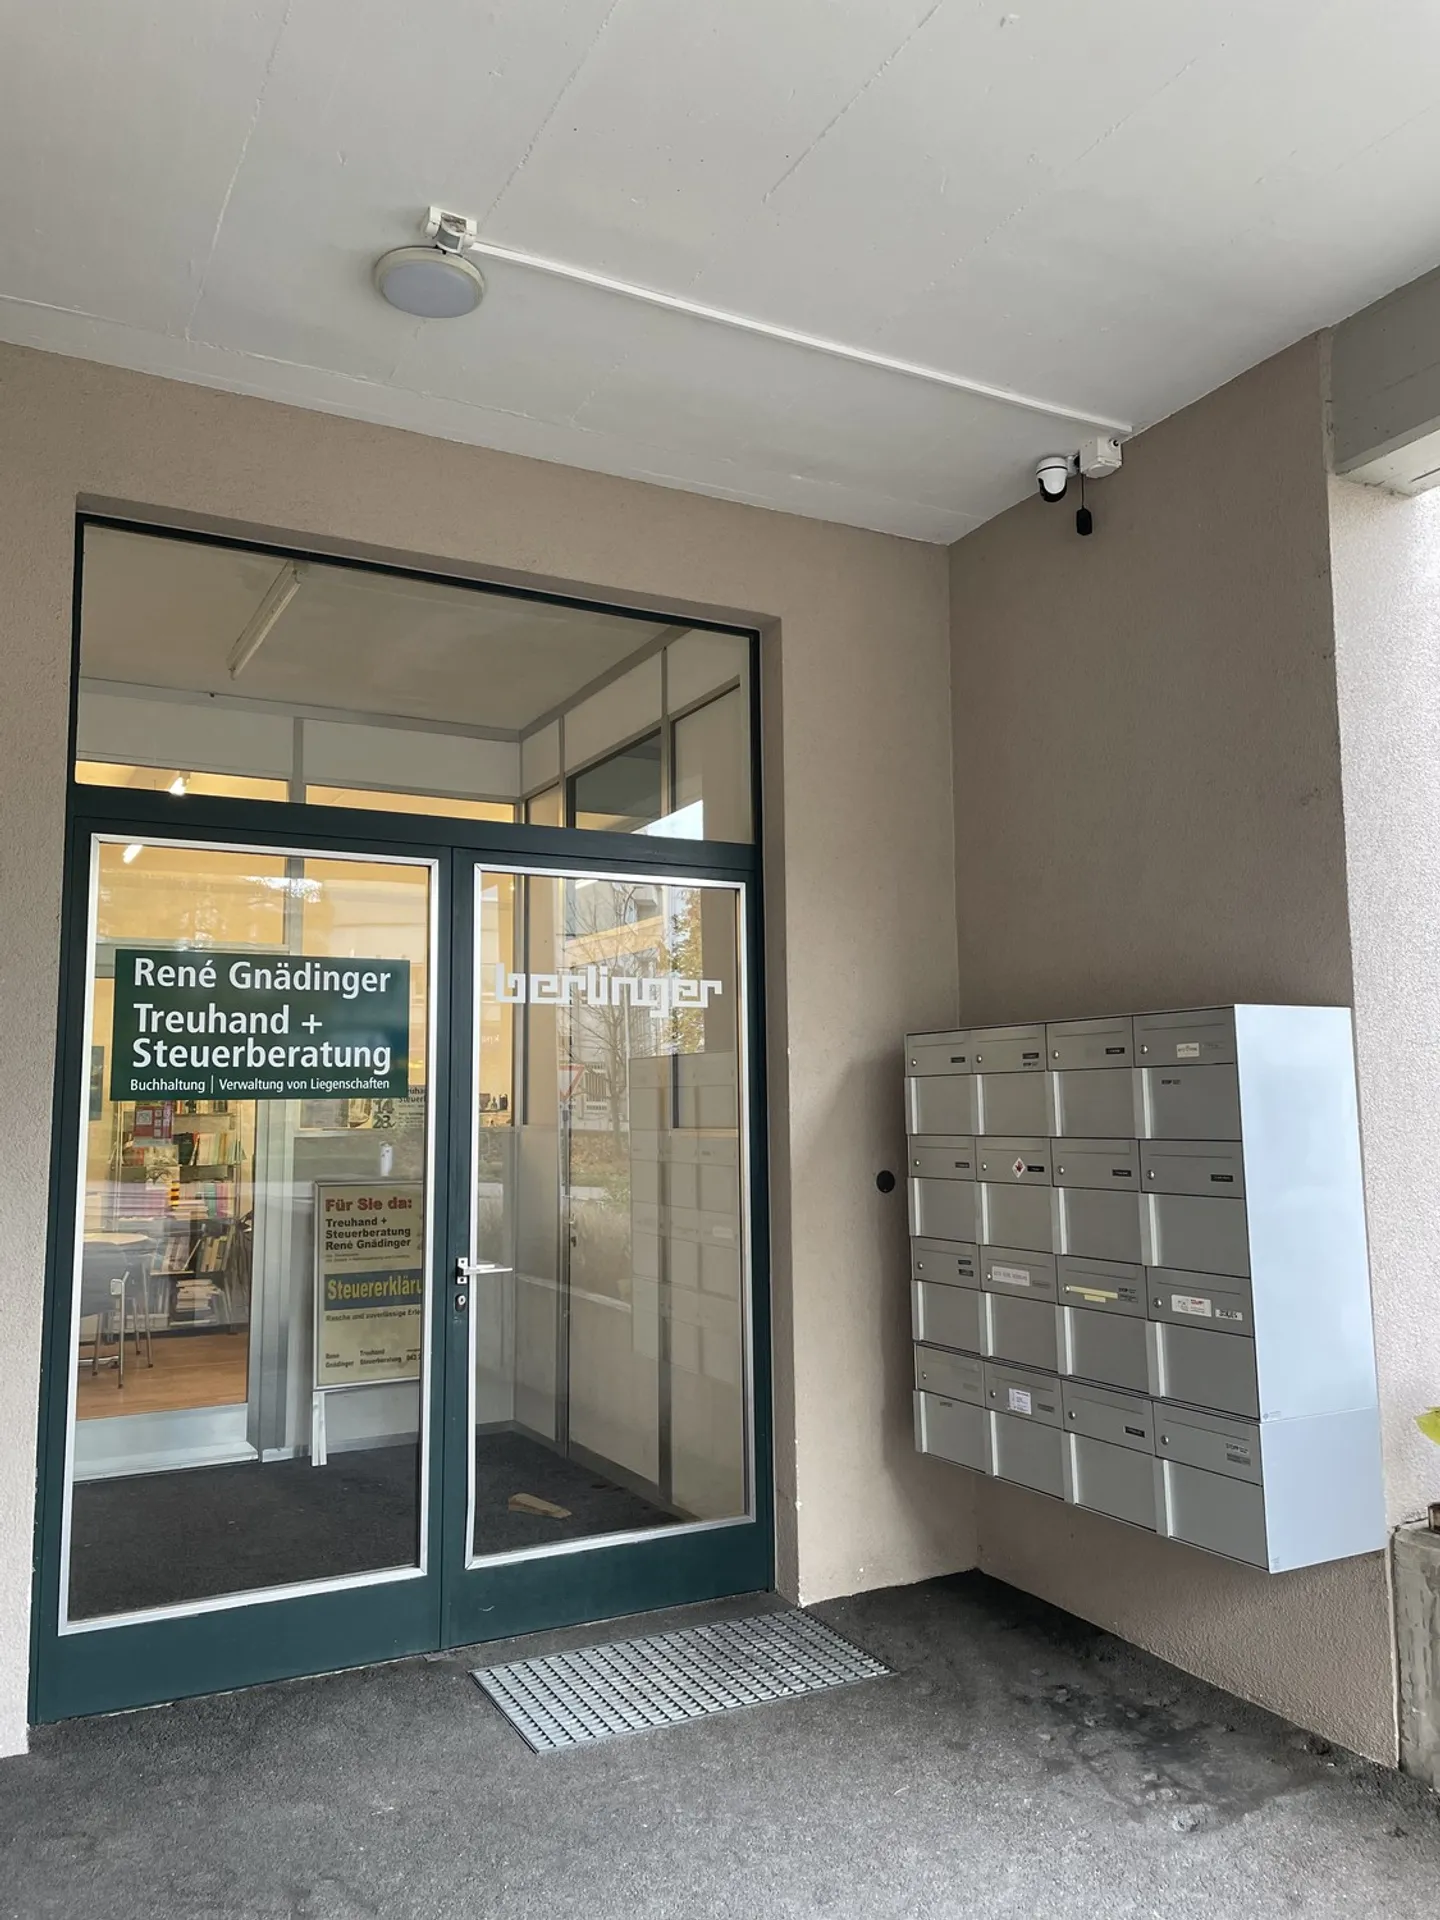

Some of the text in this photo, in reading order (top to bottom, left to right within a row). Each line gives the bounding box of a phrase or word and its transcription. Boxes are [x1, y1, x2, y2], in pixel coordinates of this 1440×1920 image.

[133, 957, 391, 999] René Gnädinger
[495, 963, 722, 1018] berlinger
[133, 1003, 323, 1035] Treuhand +
[132, 1037, 391, 1076] Steuerberatung
[130, 1077, 390, 1094] Buchhaltung Verwaltung von Liegenschaften
[325, 1196, 412, 1212] Für Sie da:
[325, 1217, 378, 1228] Treuhand
[325, 1228, 411, 1239] Steuerberatung
[325, 1239, 411, 1251] René Gnädinger
